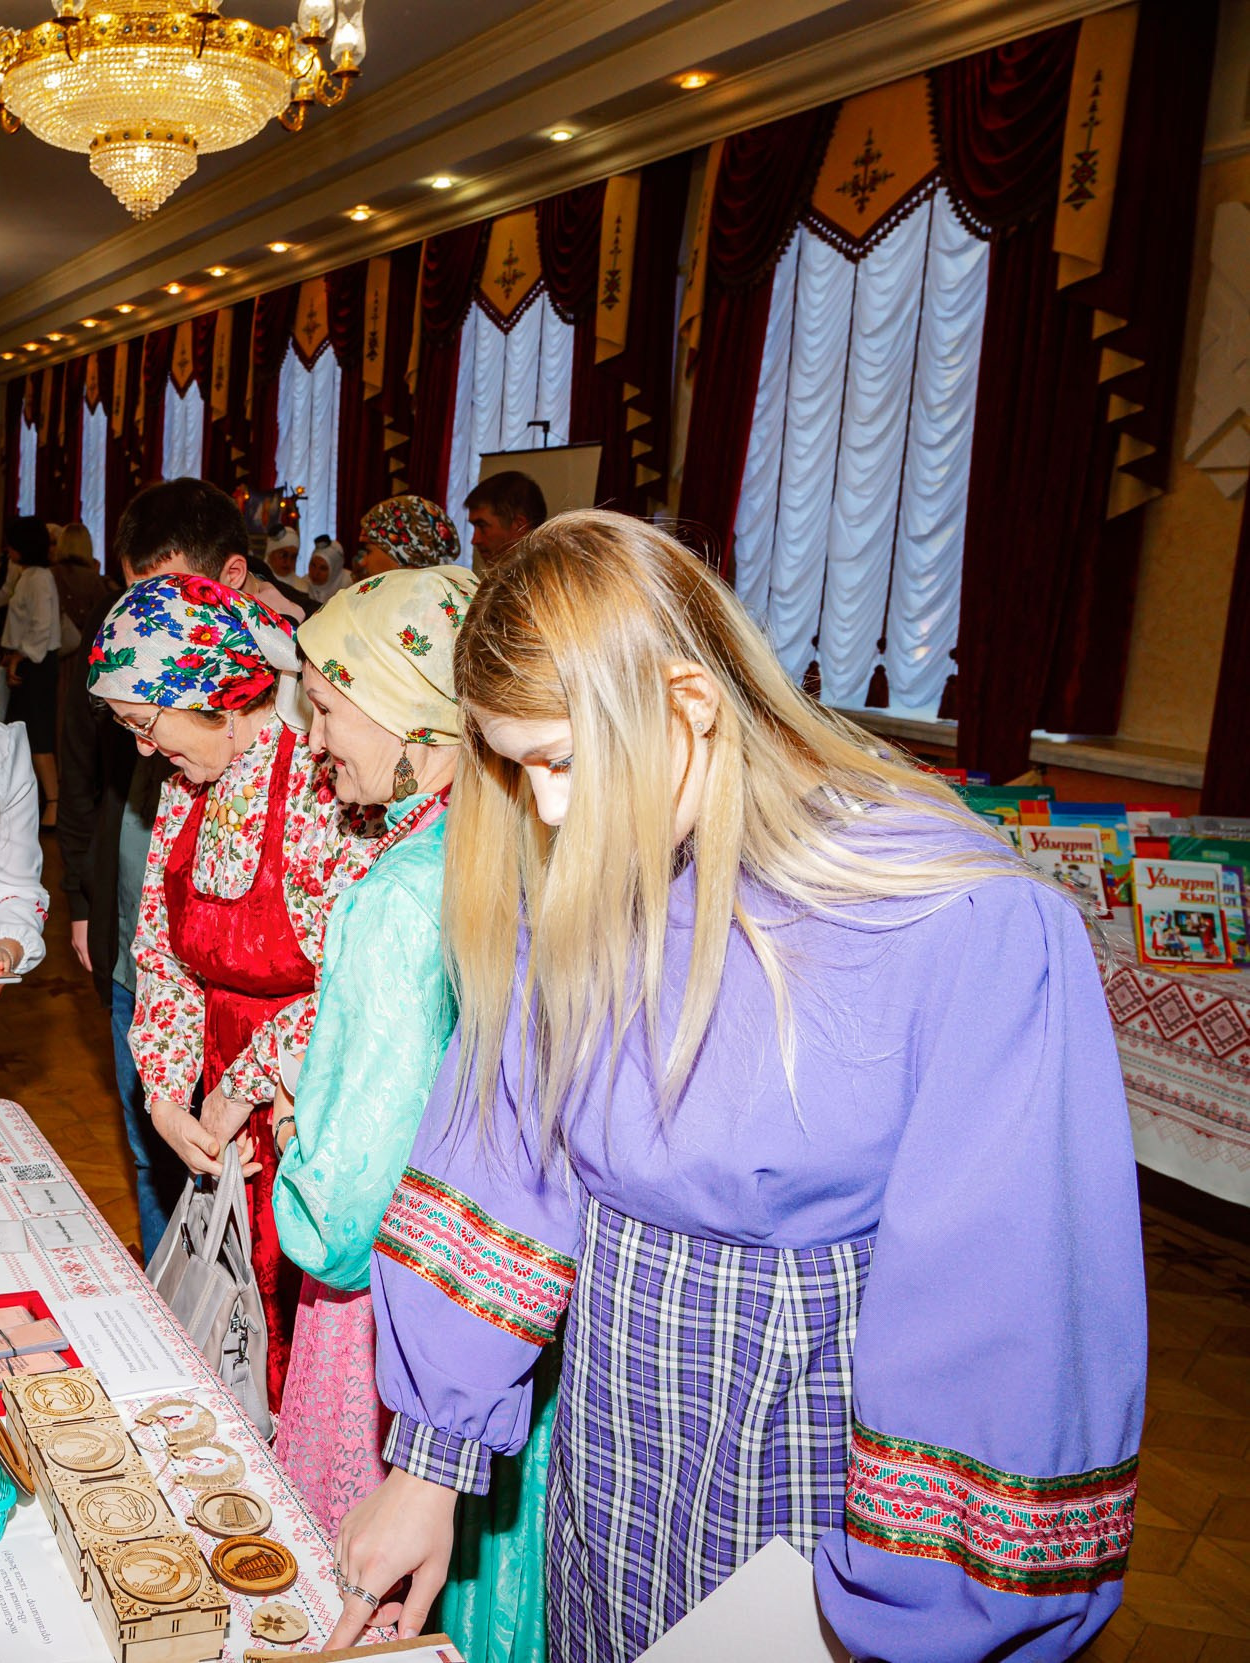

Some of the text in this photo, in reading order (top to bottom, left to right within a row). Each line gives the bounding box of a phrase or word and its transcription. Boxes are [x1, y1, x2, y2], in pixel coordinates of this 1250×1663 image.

[1030, 832, 1093, 852] Удмурт
[1061, 853, 1095, 863] кыл
[1146, 866, 1214, 891] Удмурт
[1180, 892, 1215, 903] кыл
